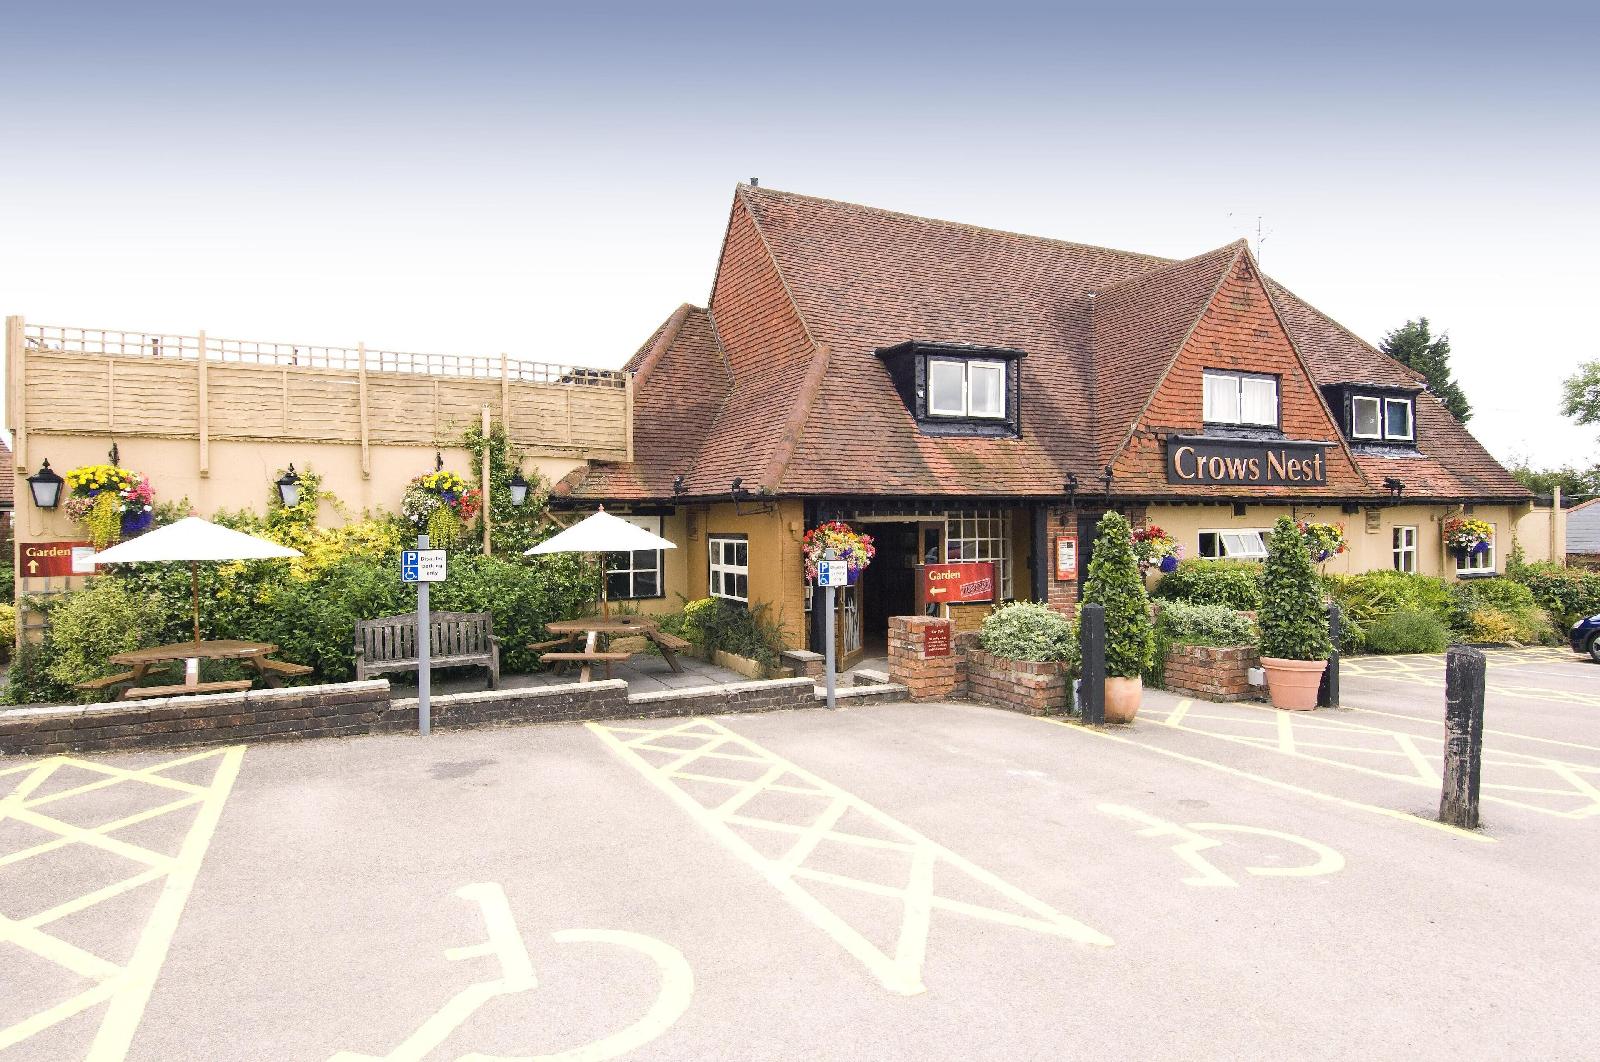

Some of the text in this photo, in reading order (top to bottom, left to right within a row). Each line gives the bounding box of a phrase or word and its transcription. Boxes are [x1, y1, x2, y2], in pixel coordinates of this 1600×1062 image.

[1174, 446, 1324, 481] Crows Nest
[26, 547, 71, 557] Garden
[407, 552, 417, 565] P
[821, 562, 829, 573] P
[928, 570, 961, 581] Garden
